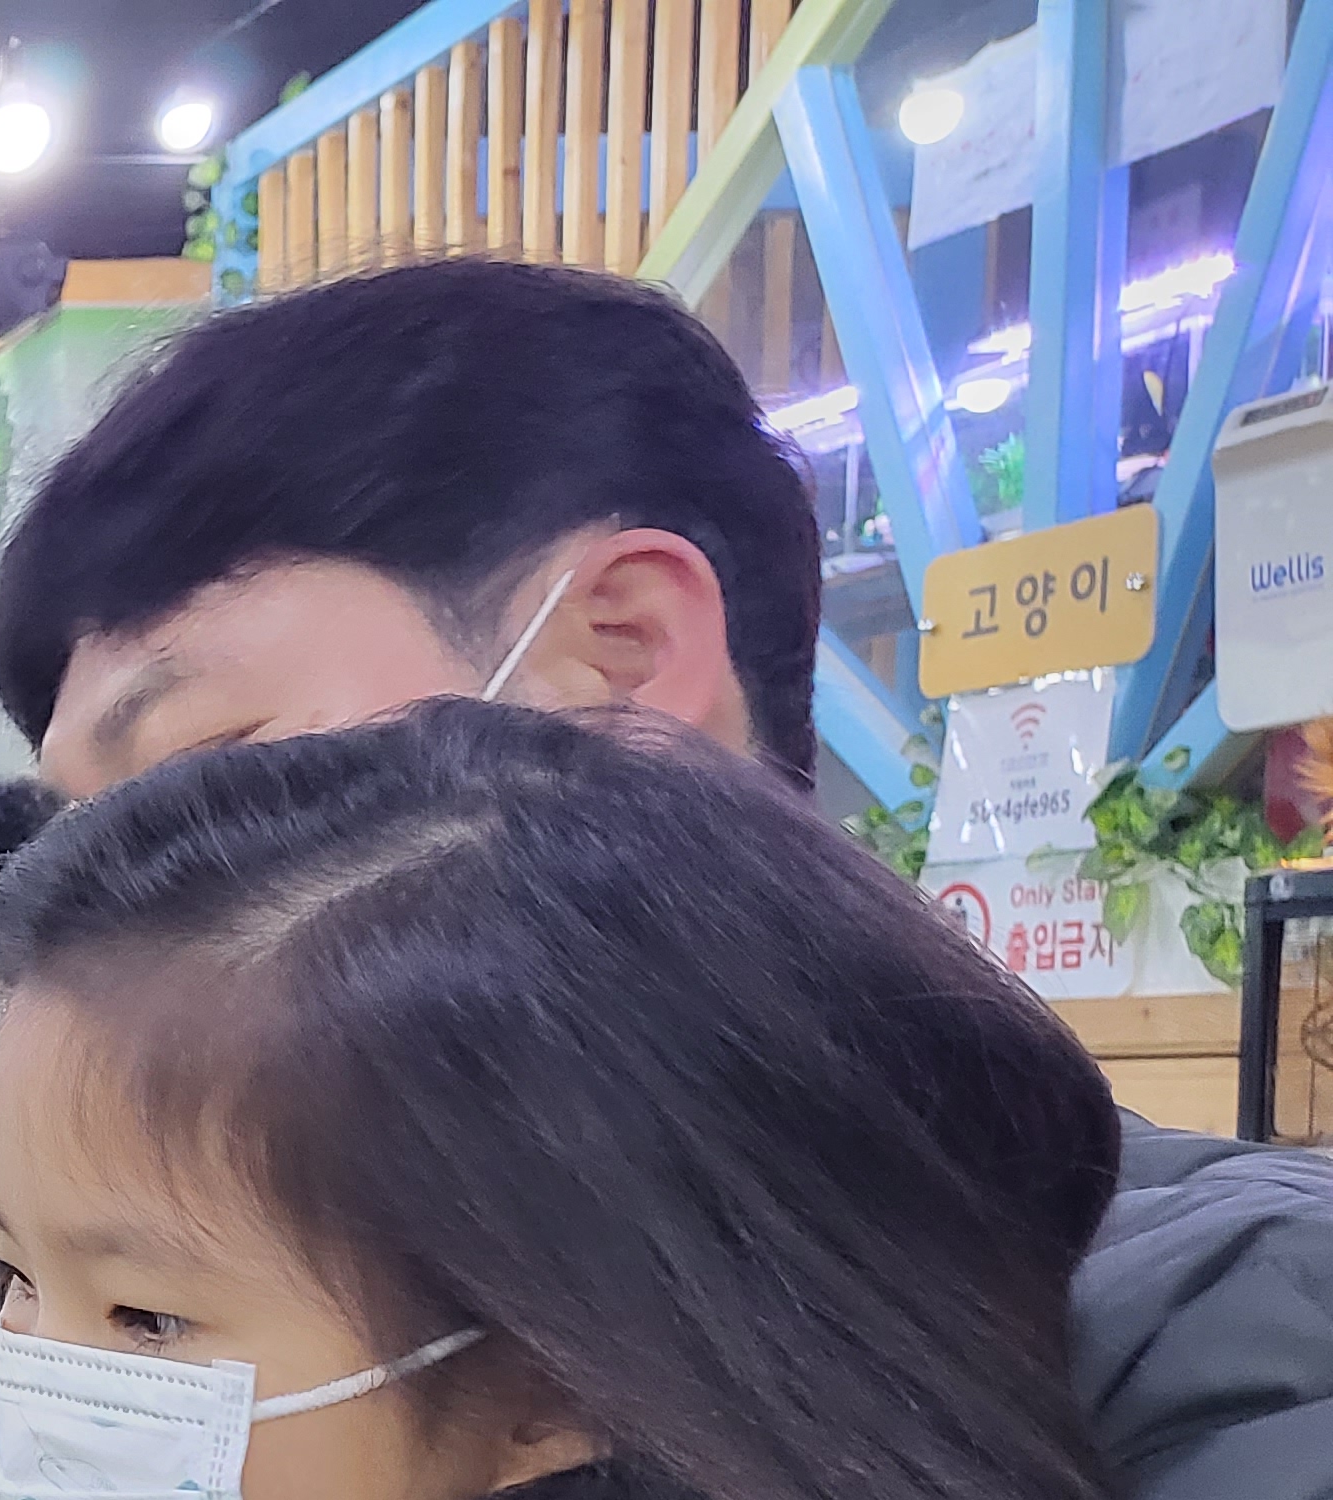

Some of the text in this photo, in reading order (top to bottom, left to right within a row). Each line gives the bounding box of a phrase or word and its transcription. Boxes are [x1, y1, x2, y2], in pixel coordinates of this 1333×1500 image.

[1251, 552, 1324, 592] Wellis
[961, 555, 1109, 638] 고양이
[1010, 873, 1102, 908] Only Sta
[1006, 919, 1114, 972] 출입금지
